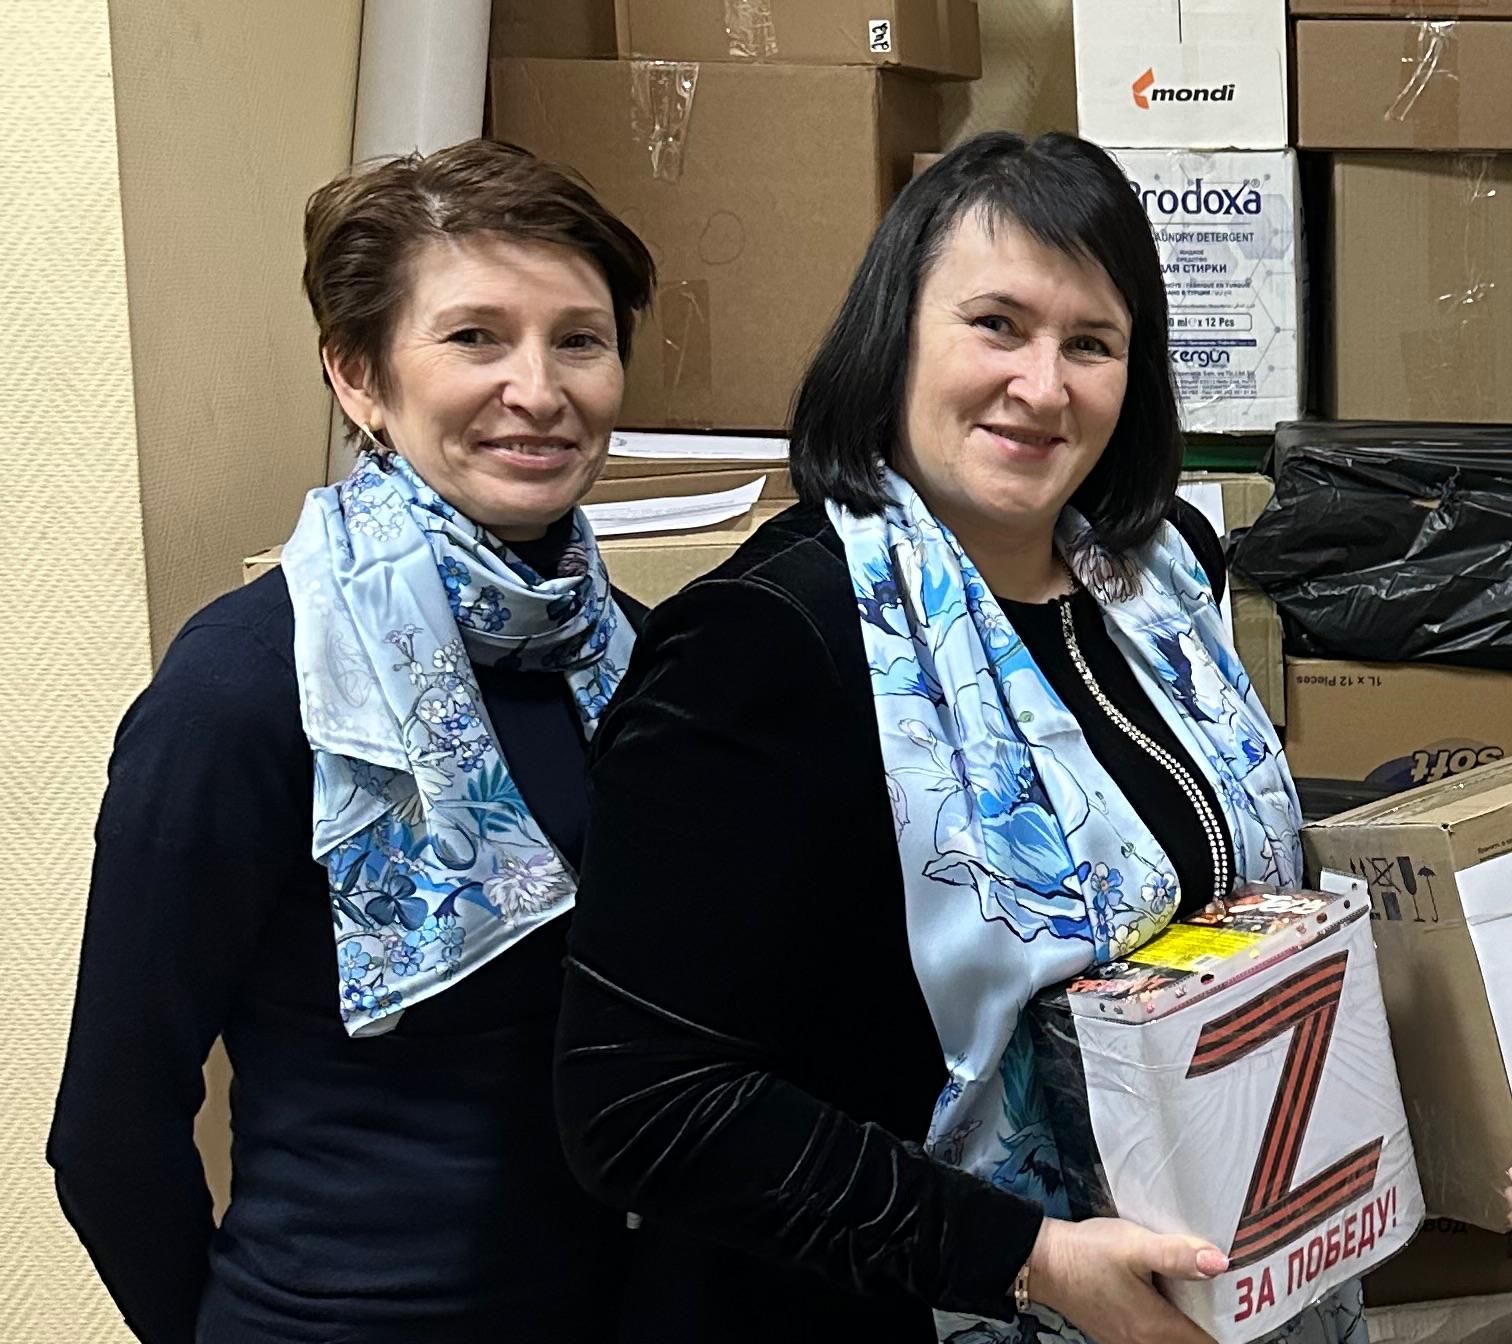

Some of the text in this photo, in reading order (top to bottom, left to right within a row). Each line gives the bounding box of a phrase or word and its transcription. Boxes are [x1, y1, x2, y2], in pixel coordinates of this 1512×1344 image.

[1151, 83, 1236, 105] mondi
[1154, 232, 1255, 243] AUNDRY DETERGENT
[1182, 263, 1227, 274] СТИРКИ
[1340, 675, 1354, 687] 12
[1234, 1185, 1398, 1323] ЗА ПОБЕДУ!
